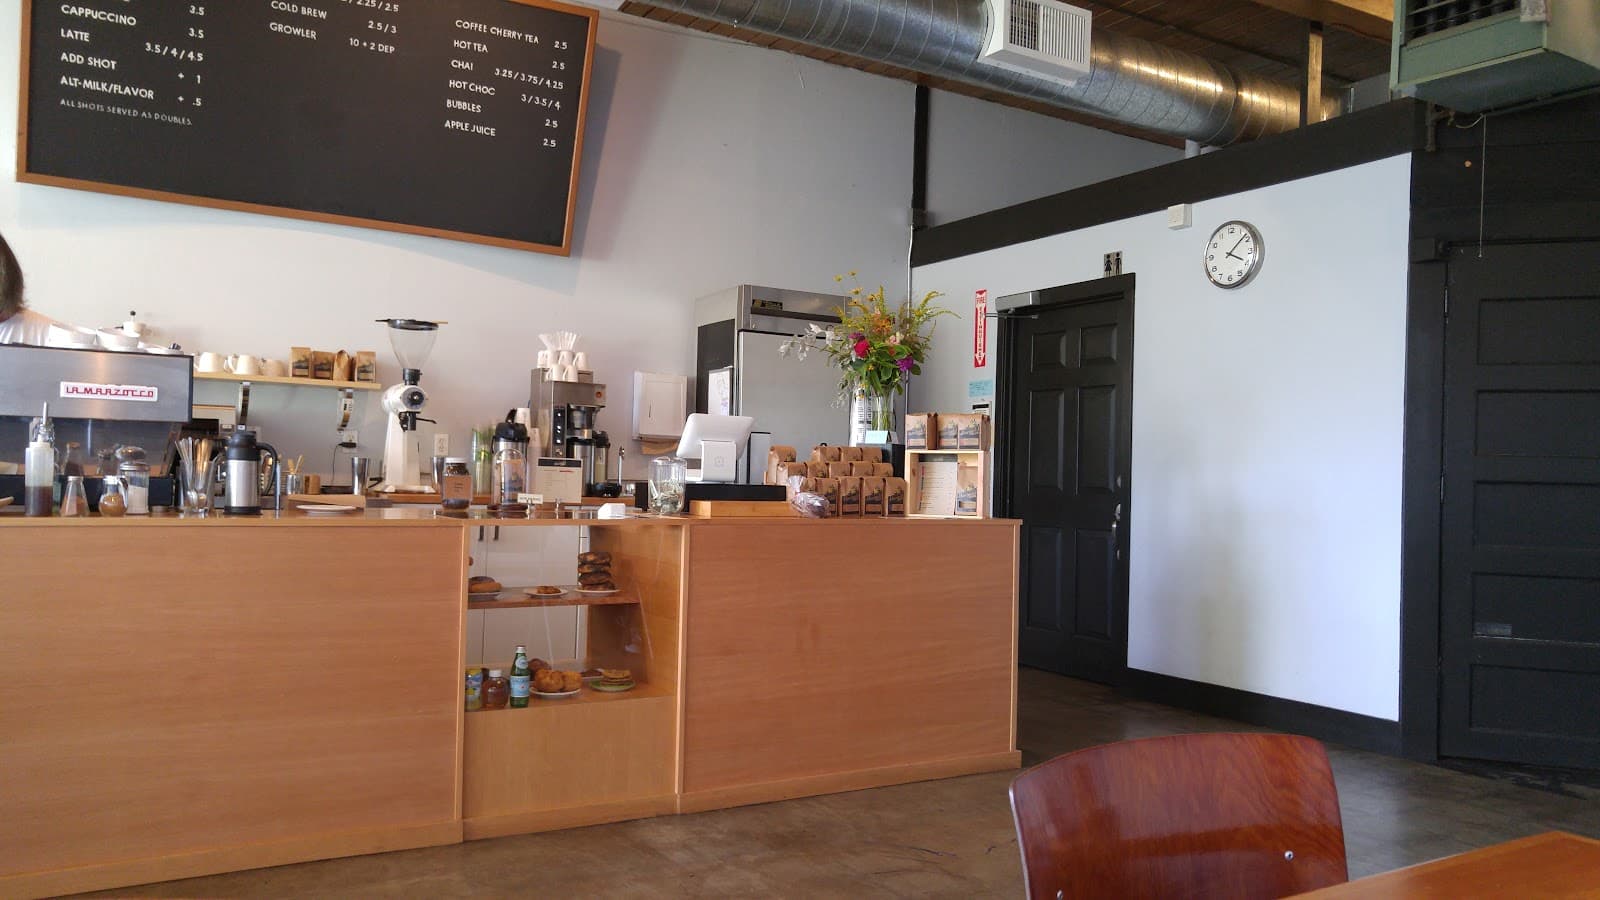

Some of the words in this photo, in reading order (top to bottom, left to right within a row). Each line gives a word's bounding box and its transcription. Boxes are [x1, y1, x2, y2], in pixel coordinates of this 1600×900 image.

[61, 5, 136, 25] CAPPUCCINO
[190, 5, 204, 15] 3.5
[271, 1, 298, 12] COLD
[302, 7, 327, 19] BREW
[270, 23, 316, 40] GROWLER
[368, 21, 382, 30] 2.5
[456, 20, 487, 32] COFFEE
[490, 27, 522, 40] CHERRY
[525, 34, 538, 44] TEA
[61, 28, 89, 42] LATTE
[189, 28, 204, 38] 3.5
[350, 38, 359, 46] 10
[378, 44, 395, 53] DEP
[454, 40, 471, 49] HOT
[473, 43, 488, 52] TEA
[554, 41, 567, 49] 2.5
[61, 53, 84, 64] ADD
[88, 57, 116, 69] SHOT
[451, 60, 473, 70] CHAI
[552, 61, 564, 70] 2.5
[61, 76, 153, 99] ALT-MILK/FLAVOR
[449, 80, 468, 89] HOT
[469, 83, 495, 95] CHOC
[60, 99, 75, 107] ALL
[77, 101, 104, 111] SHOTS
[107, 106, 138, 116] SERVED
[447, 99, 481, 112] BUBBLES
[445, 120, 469, 131] APPLE
[471, 125, 495, 136] JUICE
[545, 119, 558, 128] 2.5
[543, 138, 556, 147] 2.5
[66, 386, 79, 394] LA
